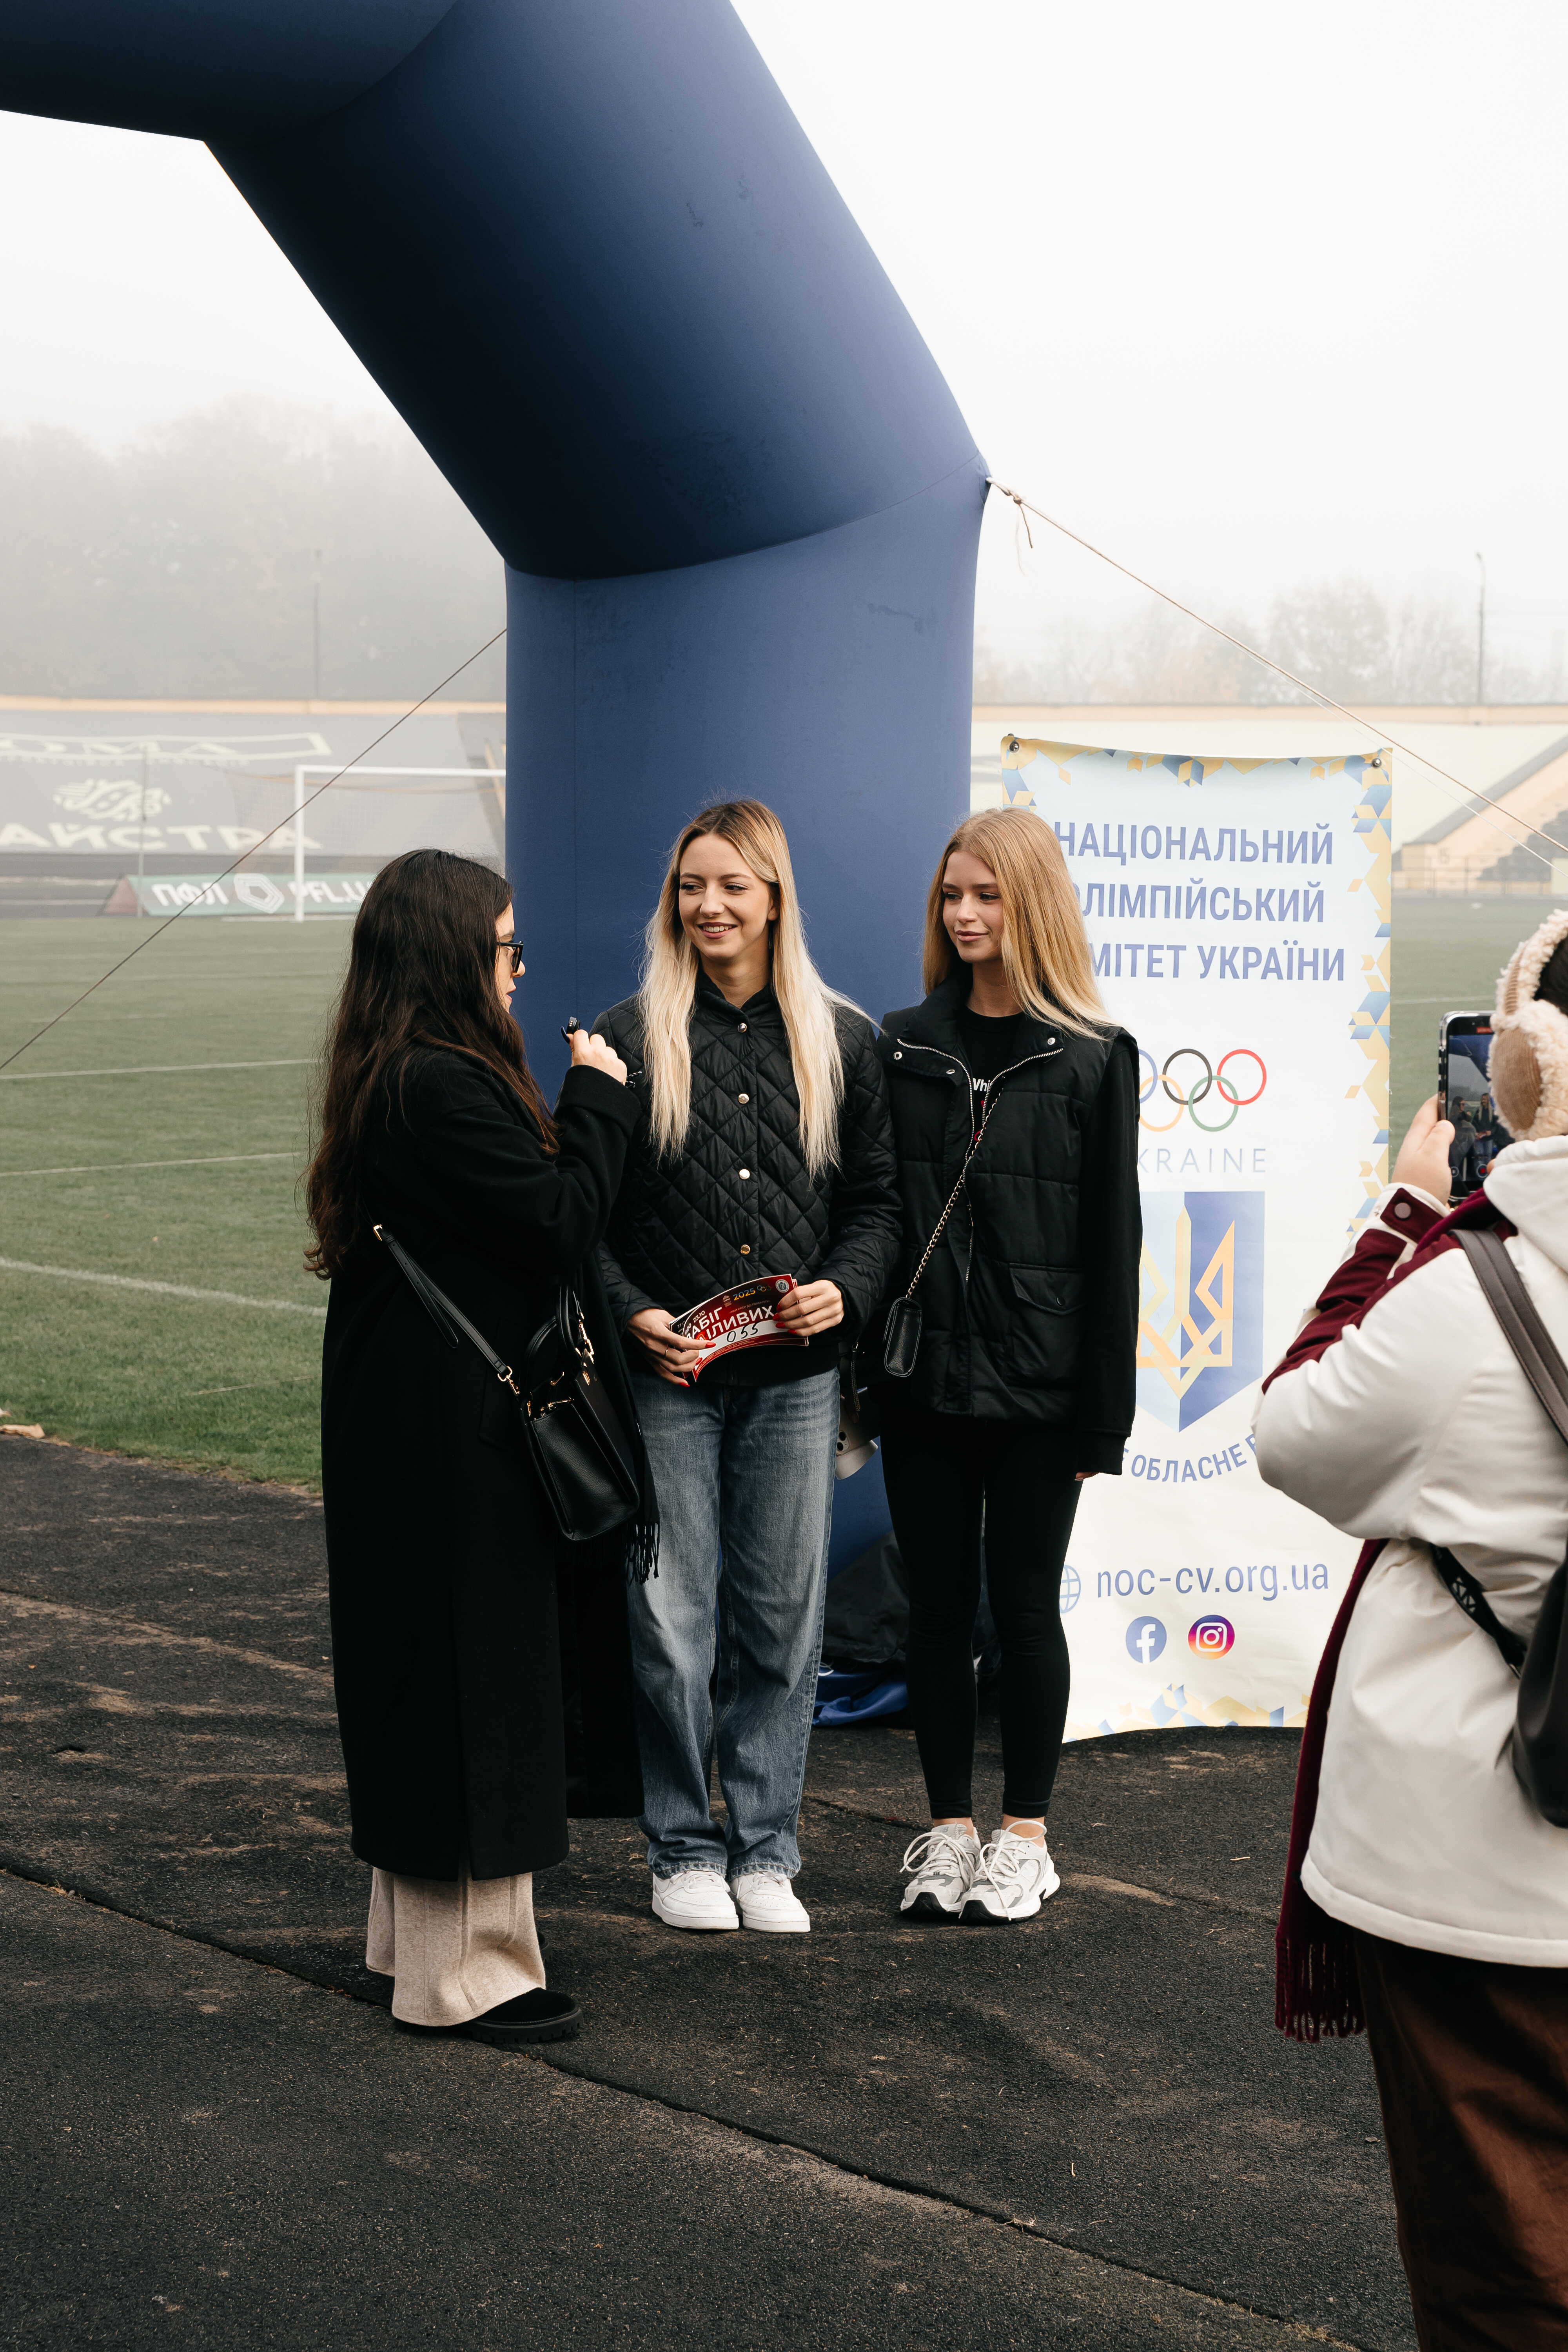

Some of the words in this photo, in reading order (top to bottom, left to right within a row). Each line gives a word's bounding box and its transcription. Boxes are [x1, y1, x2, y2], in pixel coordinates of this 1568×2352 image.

[1054, 821, 1333, 866] НАЦІОНАЛЬНИЙ
[1073, 878, 1324, 922] ЛІМПІЙСЬКИЙ
[1198, 940, 1344, 981] УКРАЇНИ
[1138, 1147, 1266, 1173] KRAINE
[733, 1288, 755, 1301] 2025
[693, 1310, 705, 1323] 23.10
[726, 1321, 761, 1343] 055
[1131, 1443, 1247, 1482] ОБЛАСНЕ
[1098, 1564, 1328, 1601] noc-cv.org.ua
